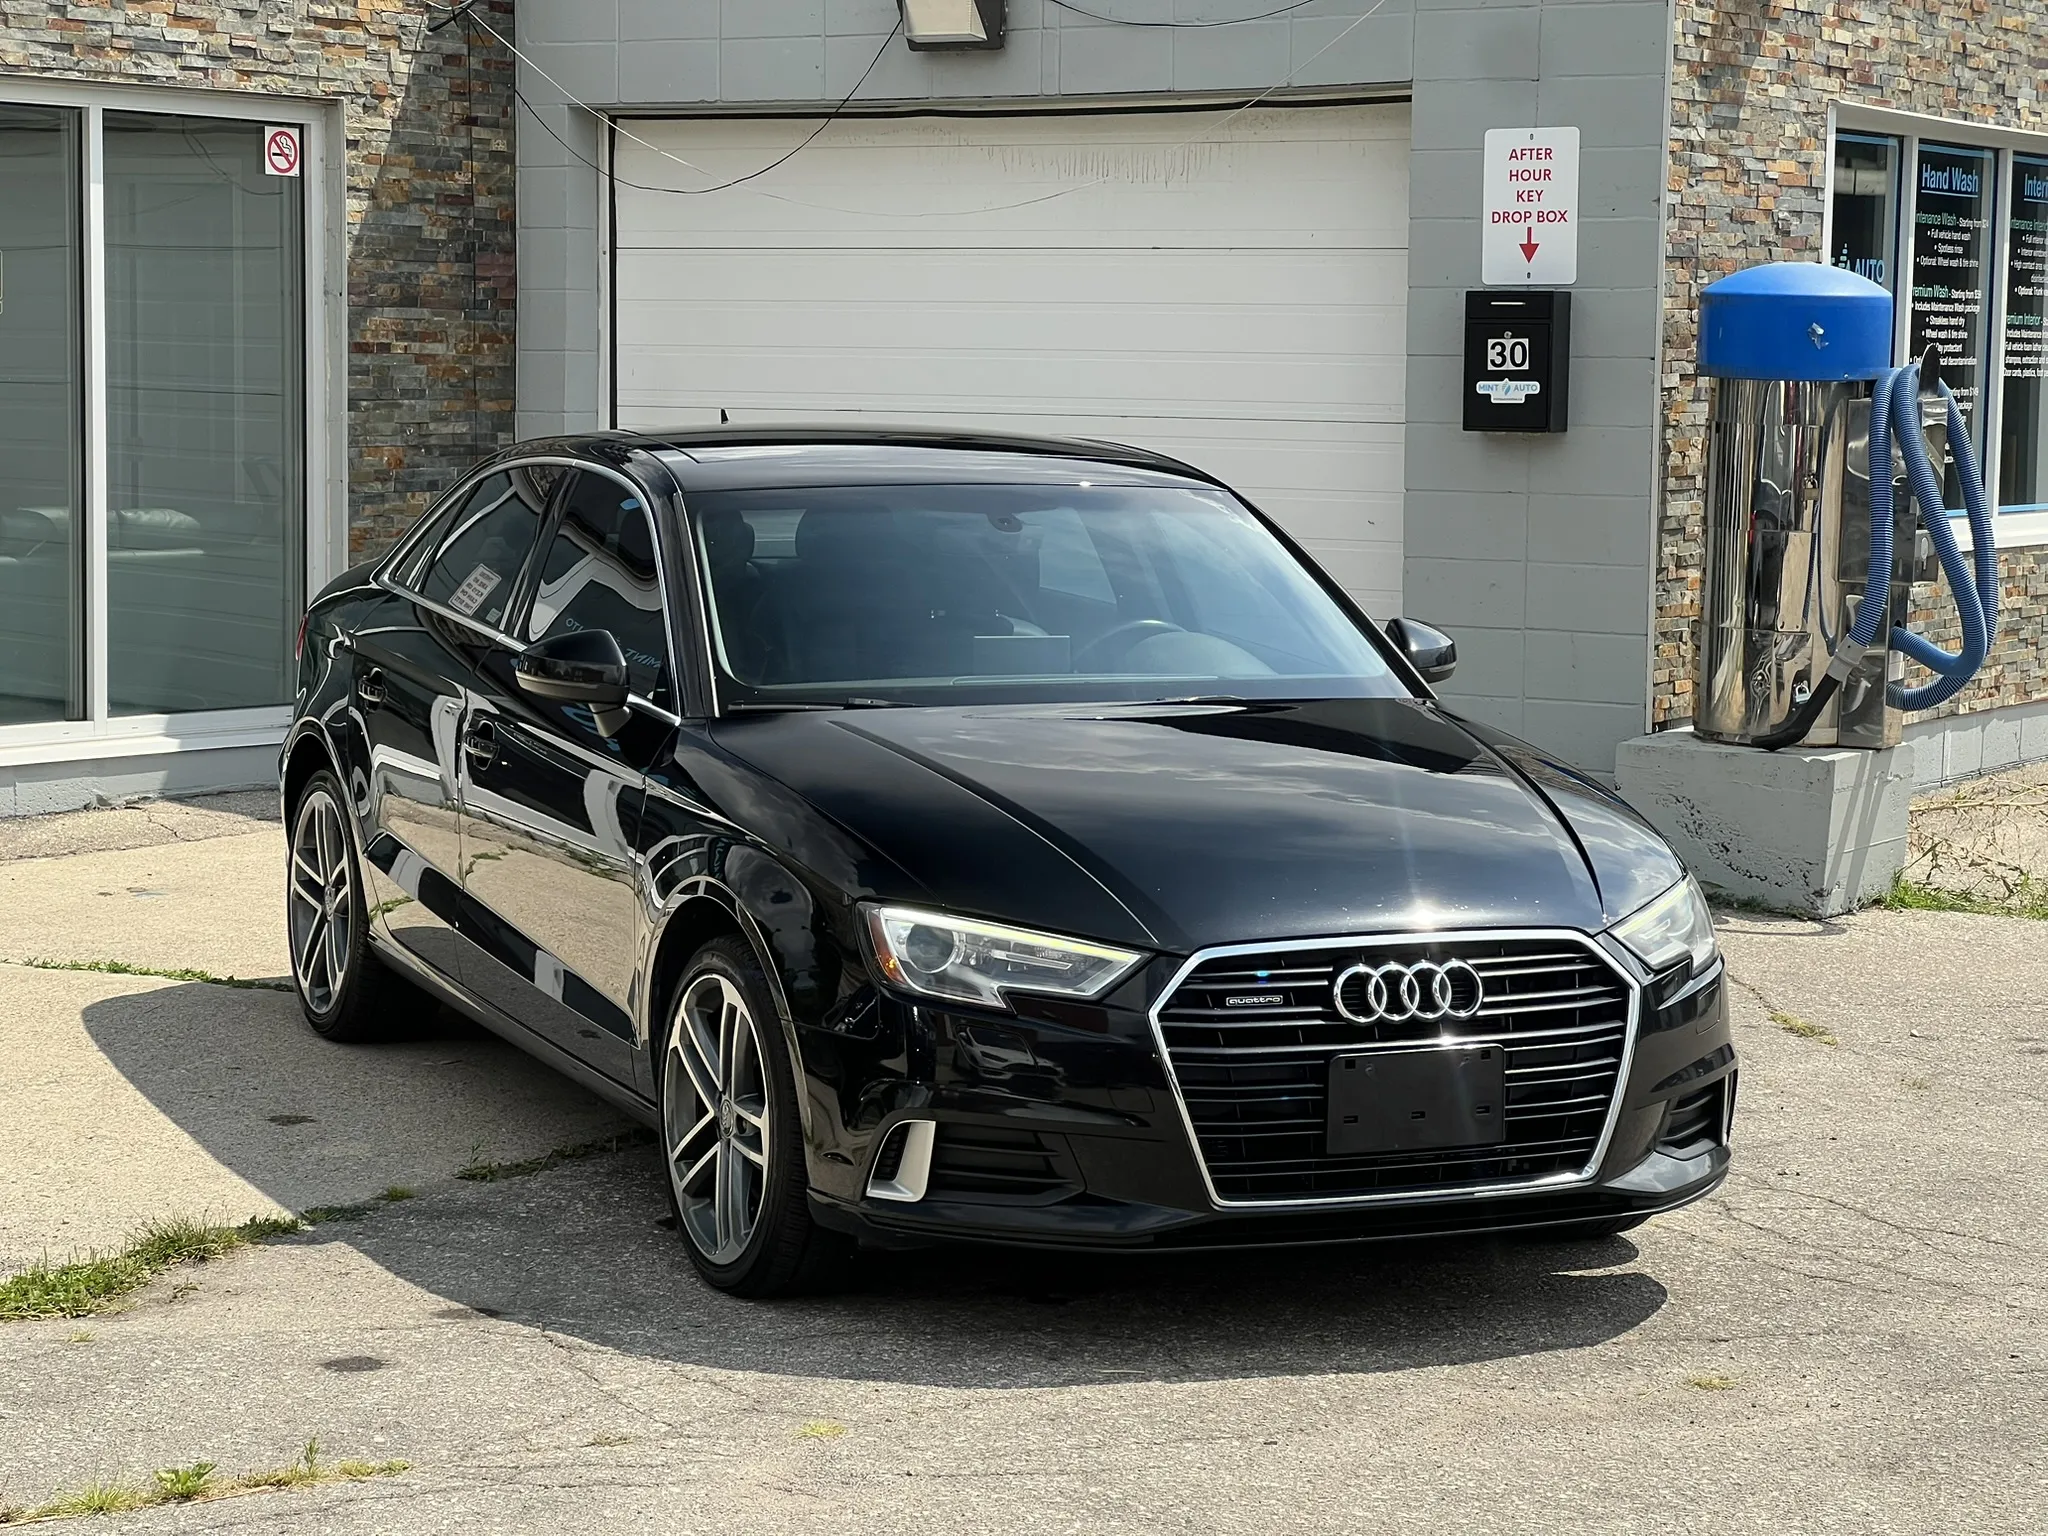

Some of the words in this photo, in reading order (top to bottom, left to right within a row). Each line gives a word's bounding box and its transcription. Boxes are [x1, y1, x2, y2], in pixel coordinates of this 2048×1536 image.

[1508, 147, 1553, 161] AFTER
[1509, 168, 1552, 182] HOUR
[1922, 163, 1950, 190] Hand
[1952, 166, 1979, 192] Wash
[1516, 189, 1544, 203] KEY
[1491, 210, 1532, 224] DROP
[1537, 209, 1568, 223] BOX
[1942, 212, 1957, 226] Wash
[1855, 258, 1885, 283] AUTO
[1934, 284, 1949, 298] Wash
[1490, 341, 1528, 369] 30
[1478, 384, 1499, 392] MINT
[1513, 384, 1538, 392] AUTO
[1229, 997, 1281, 1006] quattro
